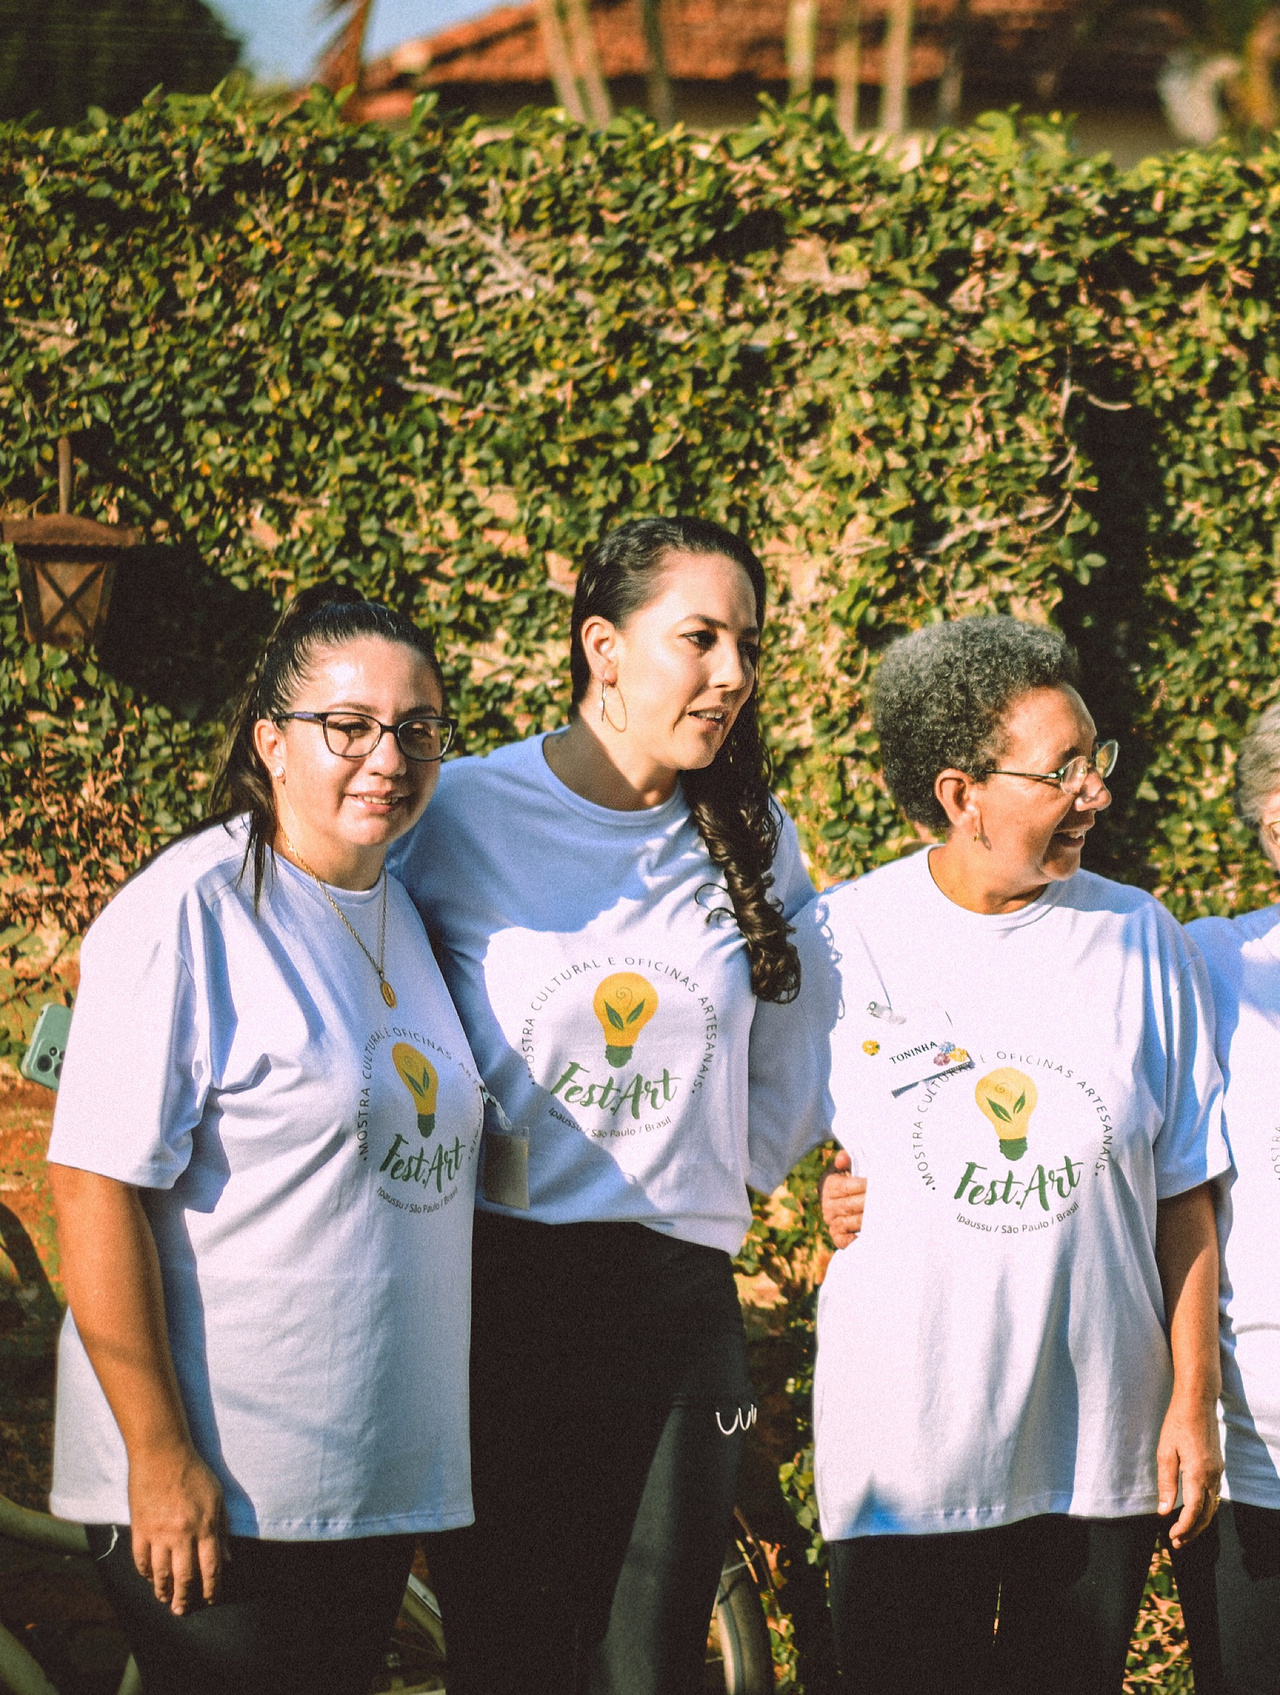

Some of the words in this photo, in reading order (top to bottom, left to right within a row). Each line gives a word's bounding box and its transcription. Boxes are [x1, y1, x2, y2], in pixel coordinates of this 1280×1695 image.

[531, 959, 601, 1012] CULTURAL
[608, 957, 616, 965] E
[625, 956, 699, 993] OFICINAS
[888, 1041, 938, 1064] TONINHA
[997, 1051, 1073, 1079] OFICINAS
[549, 1107, 583, 1132] Ipaussu
[591, 1128, 608, 1138] São
[610, 1127, 636, 1138] Paulo
[645, 1116, 672, 1132] Brasil
[956, 1212, 992, 1232] Ipaussu
[1001, 1223, 1019, 1234] São
[1022, 1221, 1049, 1232] Paulo
[1056, 1201, 1079, 1223] Brasil
